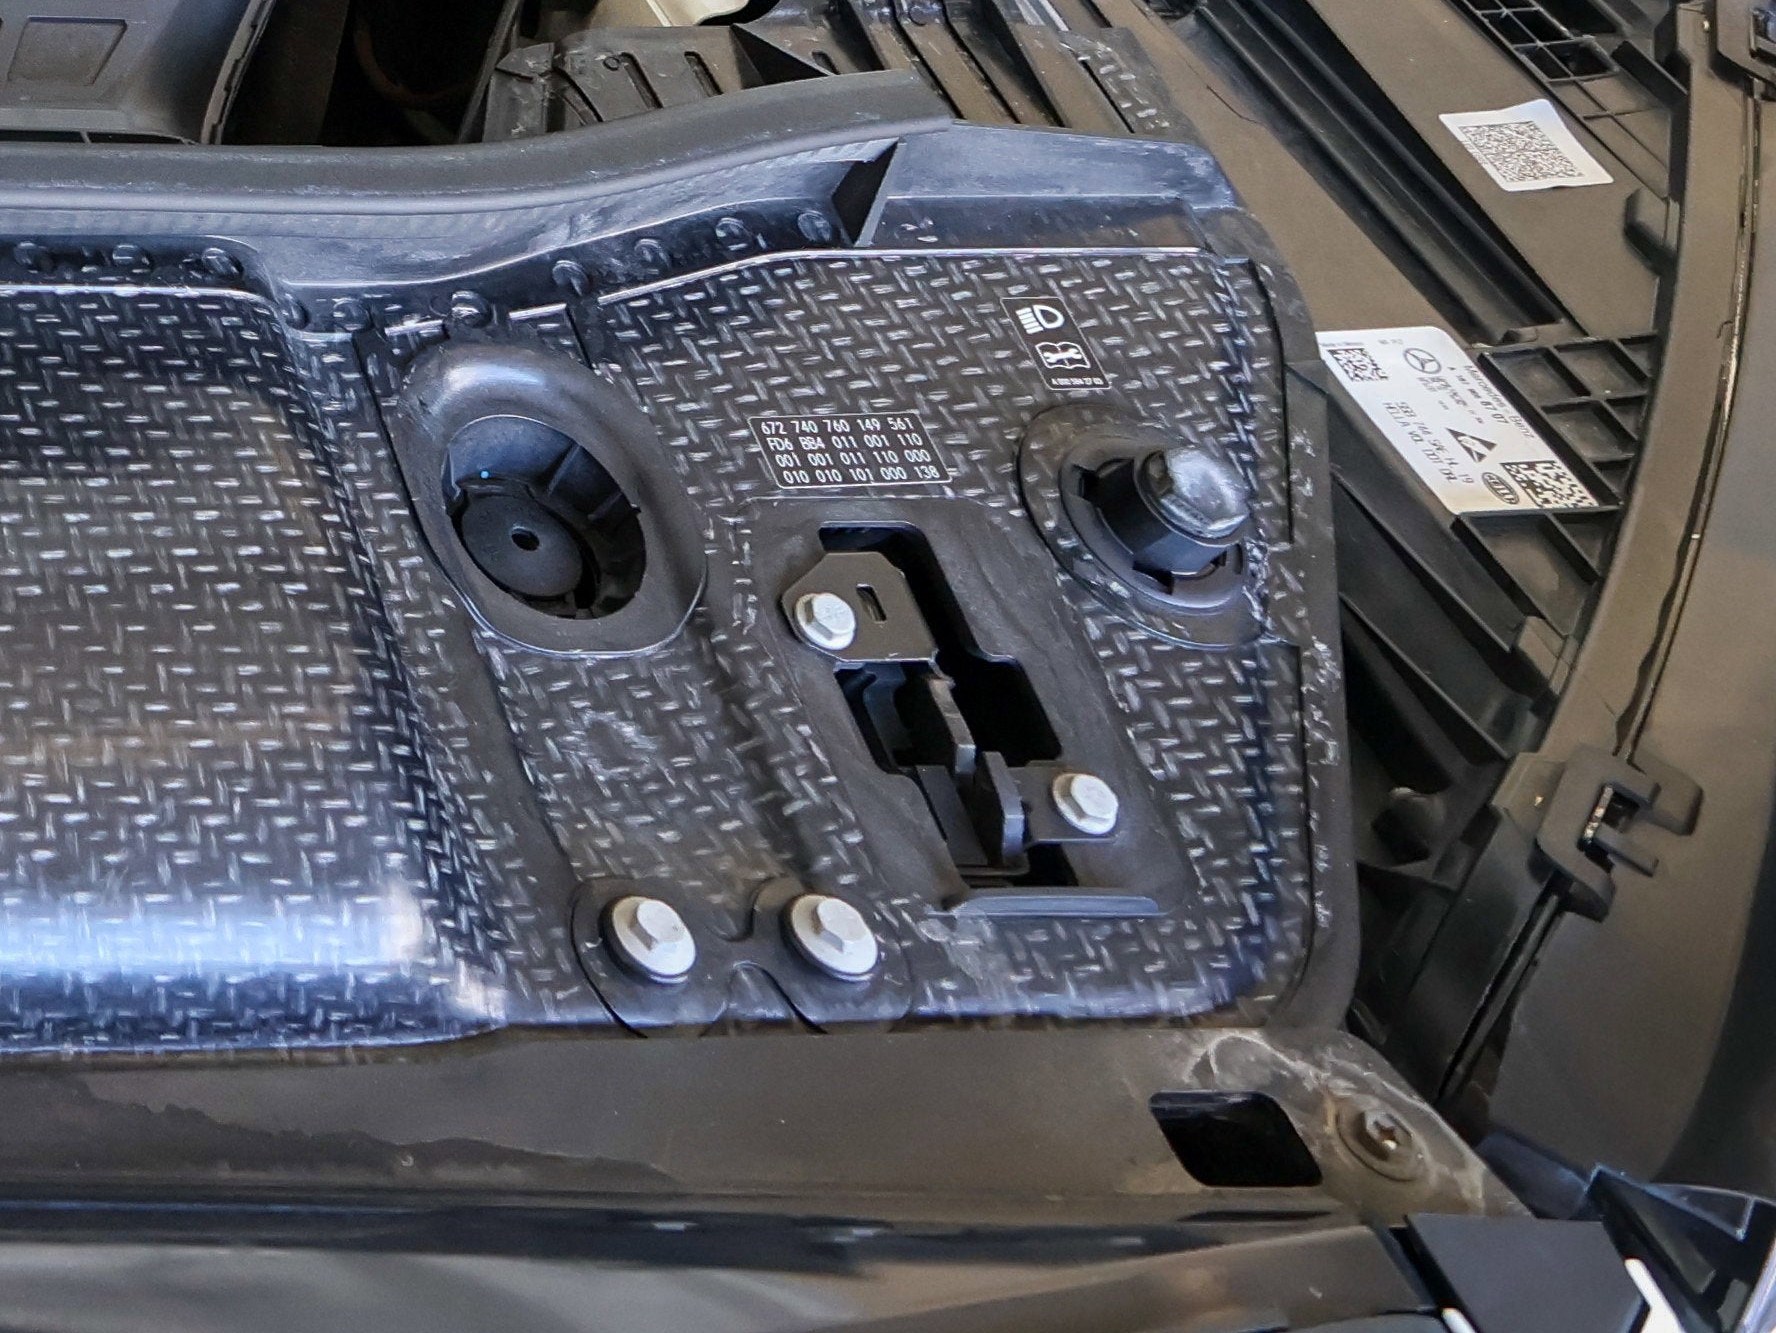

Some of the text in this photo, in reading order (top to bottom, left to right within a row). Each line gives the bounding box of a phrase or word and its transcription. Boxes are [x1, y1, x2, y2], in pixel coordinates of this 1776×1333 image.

[761, 418, 914, 434] 672 740 760 149 561
[767, 437, 793, 451] FD6
[832, 436, 858, 449] 011
[864, 435, 890, 447] 001
[898, 433, 923, 446] 110
[775, 449, 931, 467] 001 001 011 110 000
[783, 466, 939, 483] 010 010 101 000 138
